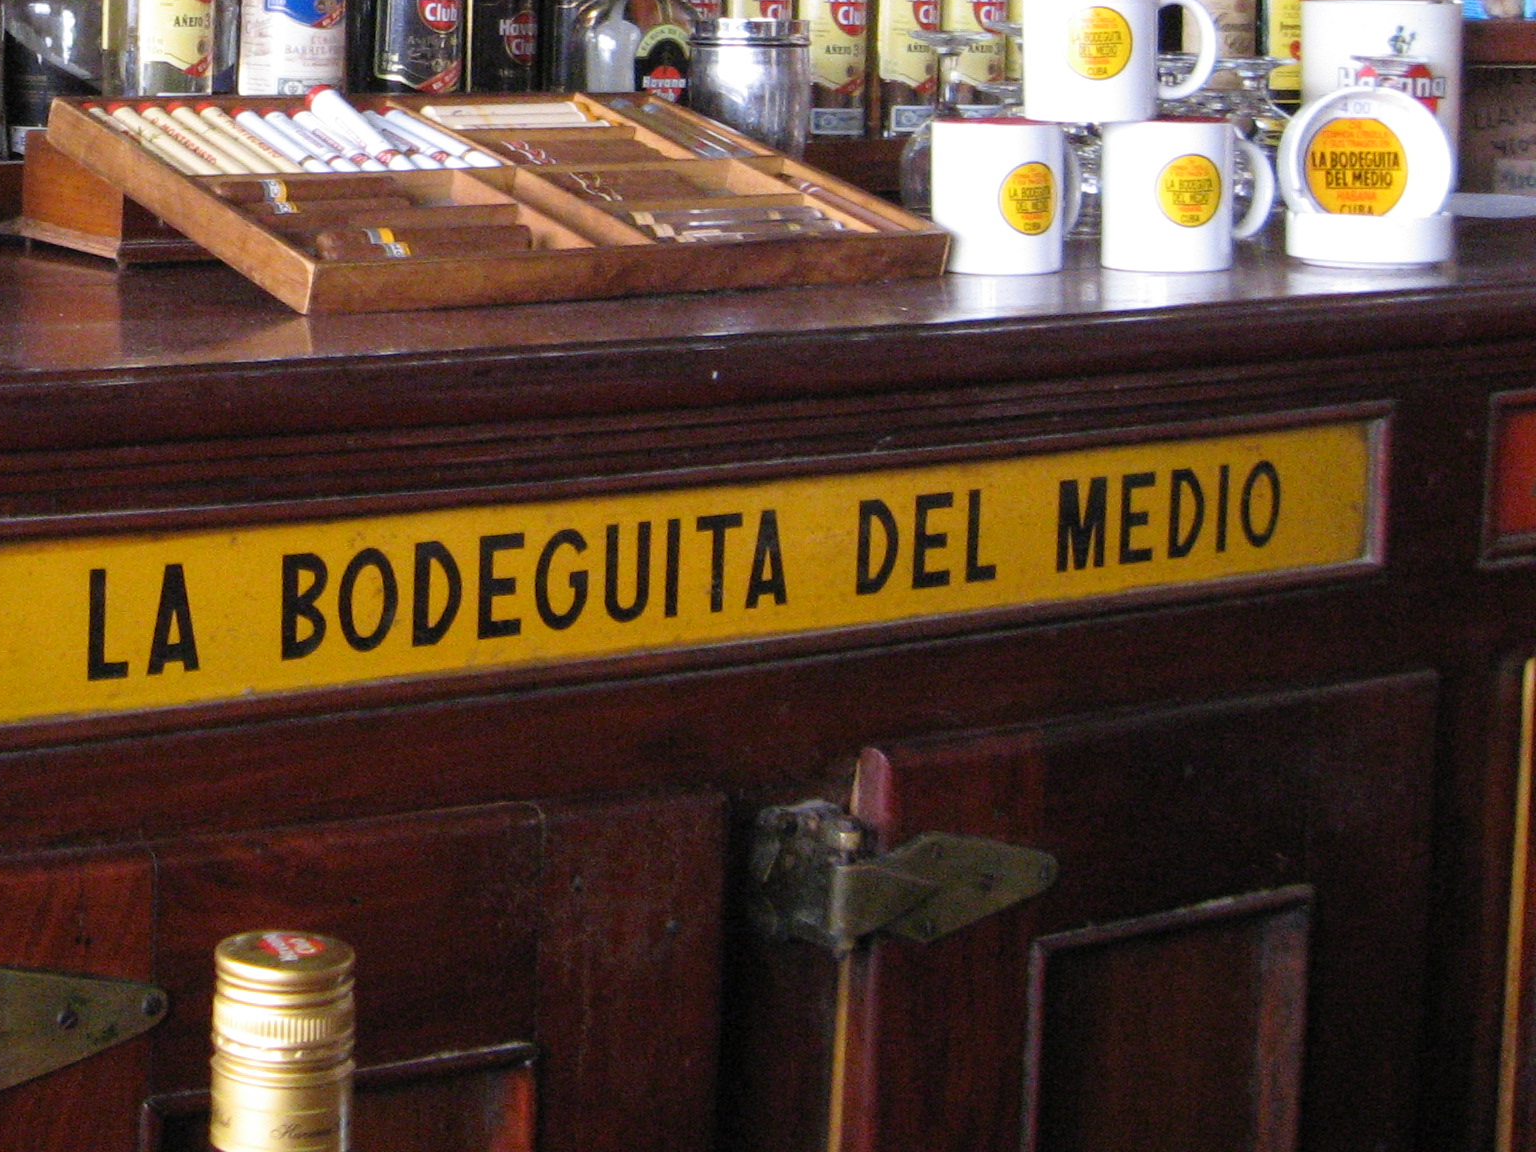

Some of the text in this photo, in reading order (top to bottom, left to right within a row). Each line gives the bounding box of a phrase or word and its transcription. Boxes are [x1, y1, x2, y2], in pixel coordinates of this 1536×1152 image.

[425, 3, 458, 21] Club
[174, 15, 203, 28] AÑEJO
[1087, 67, 1107, 76] CUBA
[642, 76, 688, 89] Havana
[1311, 151, 1400, 168] LA BODEGUITA
[1165, 179, 1175, 190] LA
[1326, 171, 1393, 187] DEL MEDIO
[1008, 187, 1018, 198] LA
[1173, 192, 1186, 204] DEL
[1339, 204, 1374, 215] CUBA
[1180, 214, 1201, 223] CUBA
[1023, 222, 1041, 231] CUBA
[88, 459, 1282, 681] LA BODEGUITA DEL MEDIO
